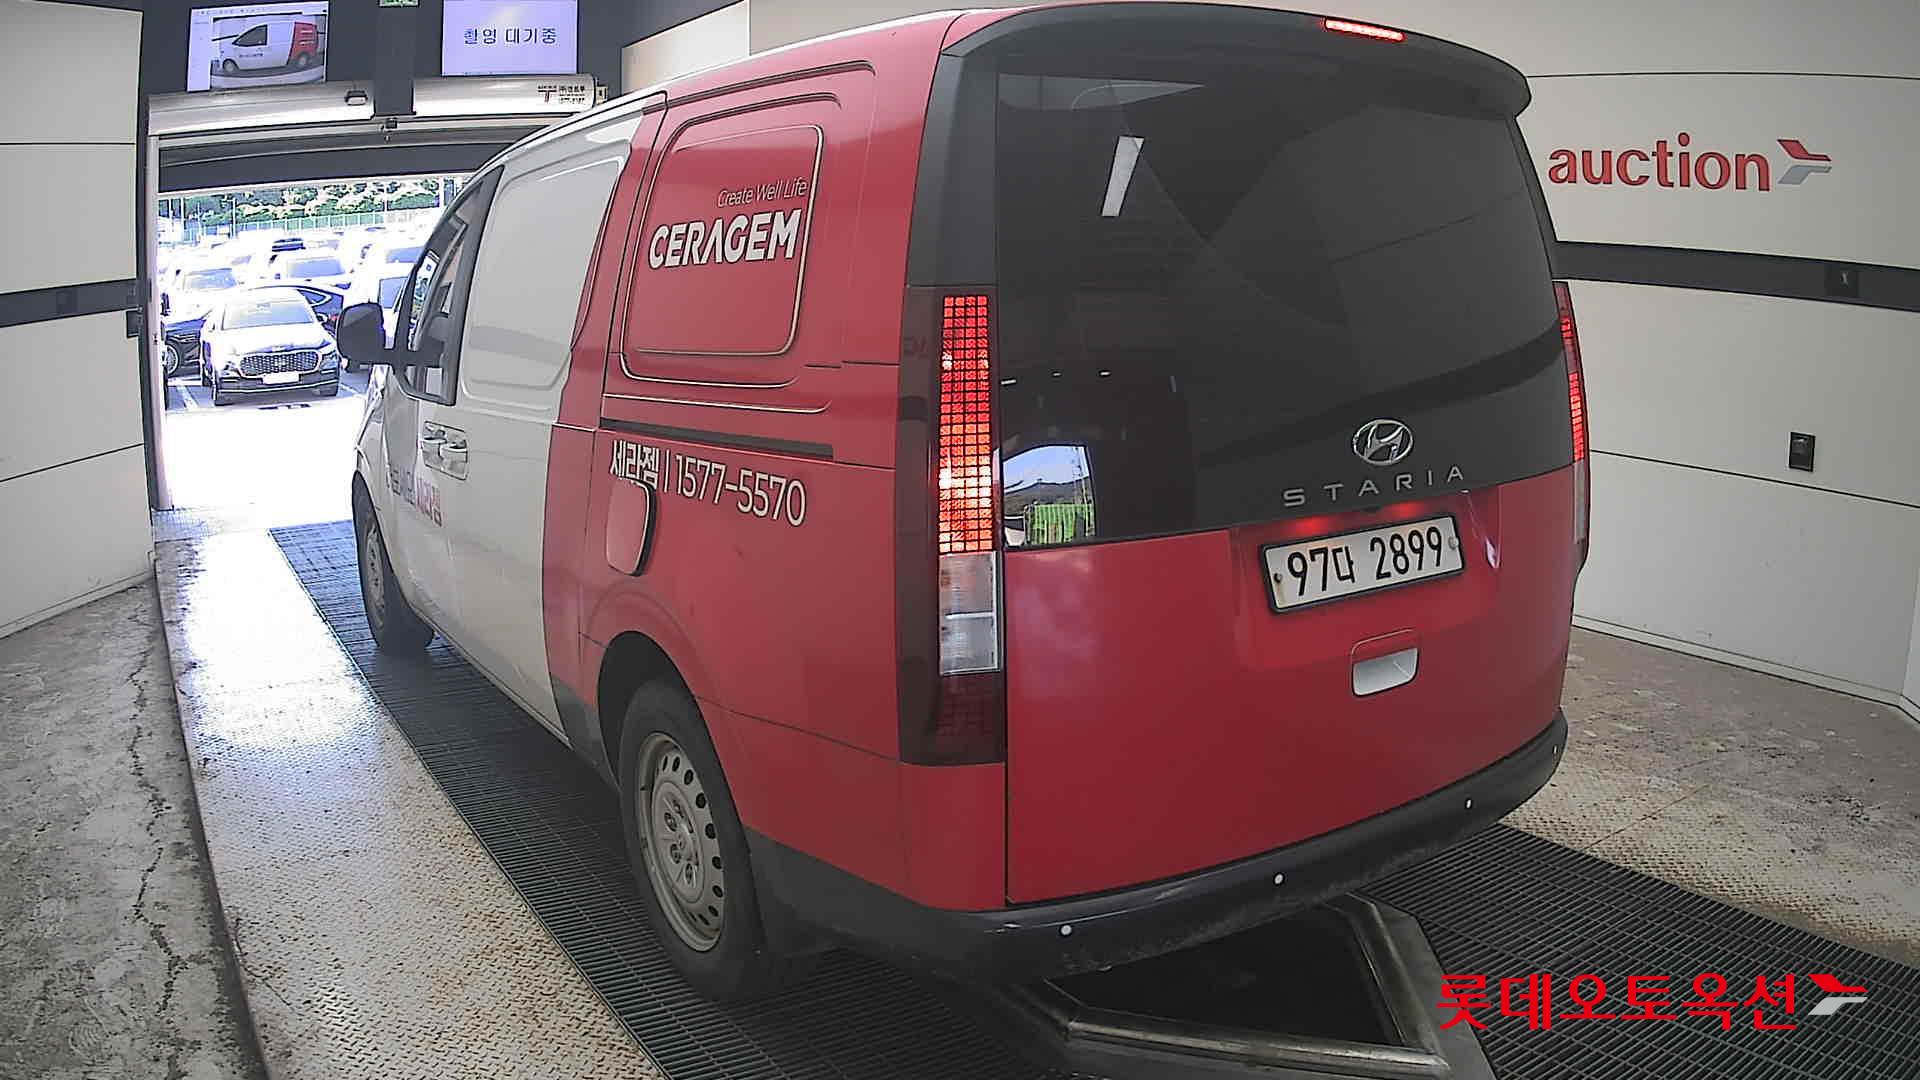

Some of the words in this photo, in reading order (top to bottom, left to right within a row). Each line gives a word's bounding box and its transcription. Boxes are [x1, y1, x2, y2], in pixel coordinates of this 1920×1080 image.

[505, 28, 557, 45] 대기중
[1548, 132, 1770, 191] auction
[717, 187, 753, 208] Create
[755, 182, 782, 202] Well
[783, 176, 808, 198] Life
[648, 208, 803, 269] CERAGEM
[609, 439, 659, 490] 세라젬
[675, 454, 806, 527] 1577-5570
[1283, 465, 1464, 508] STARIA
[1287, 545, 1355, 597] 97다
[1369, 526, 1443, 580] 2899
